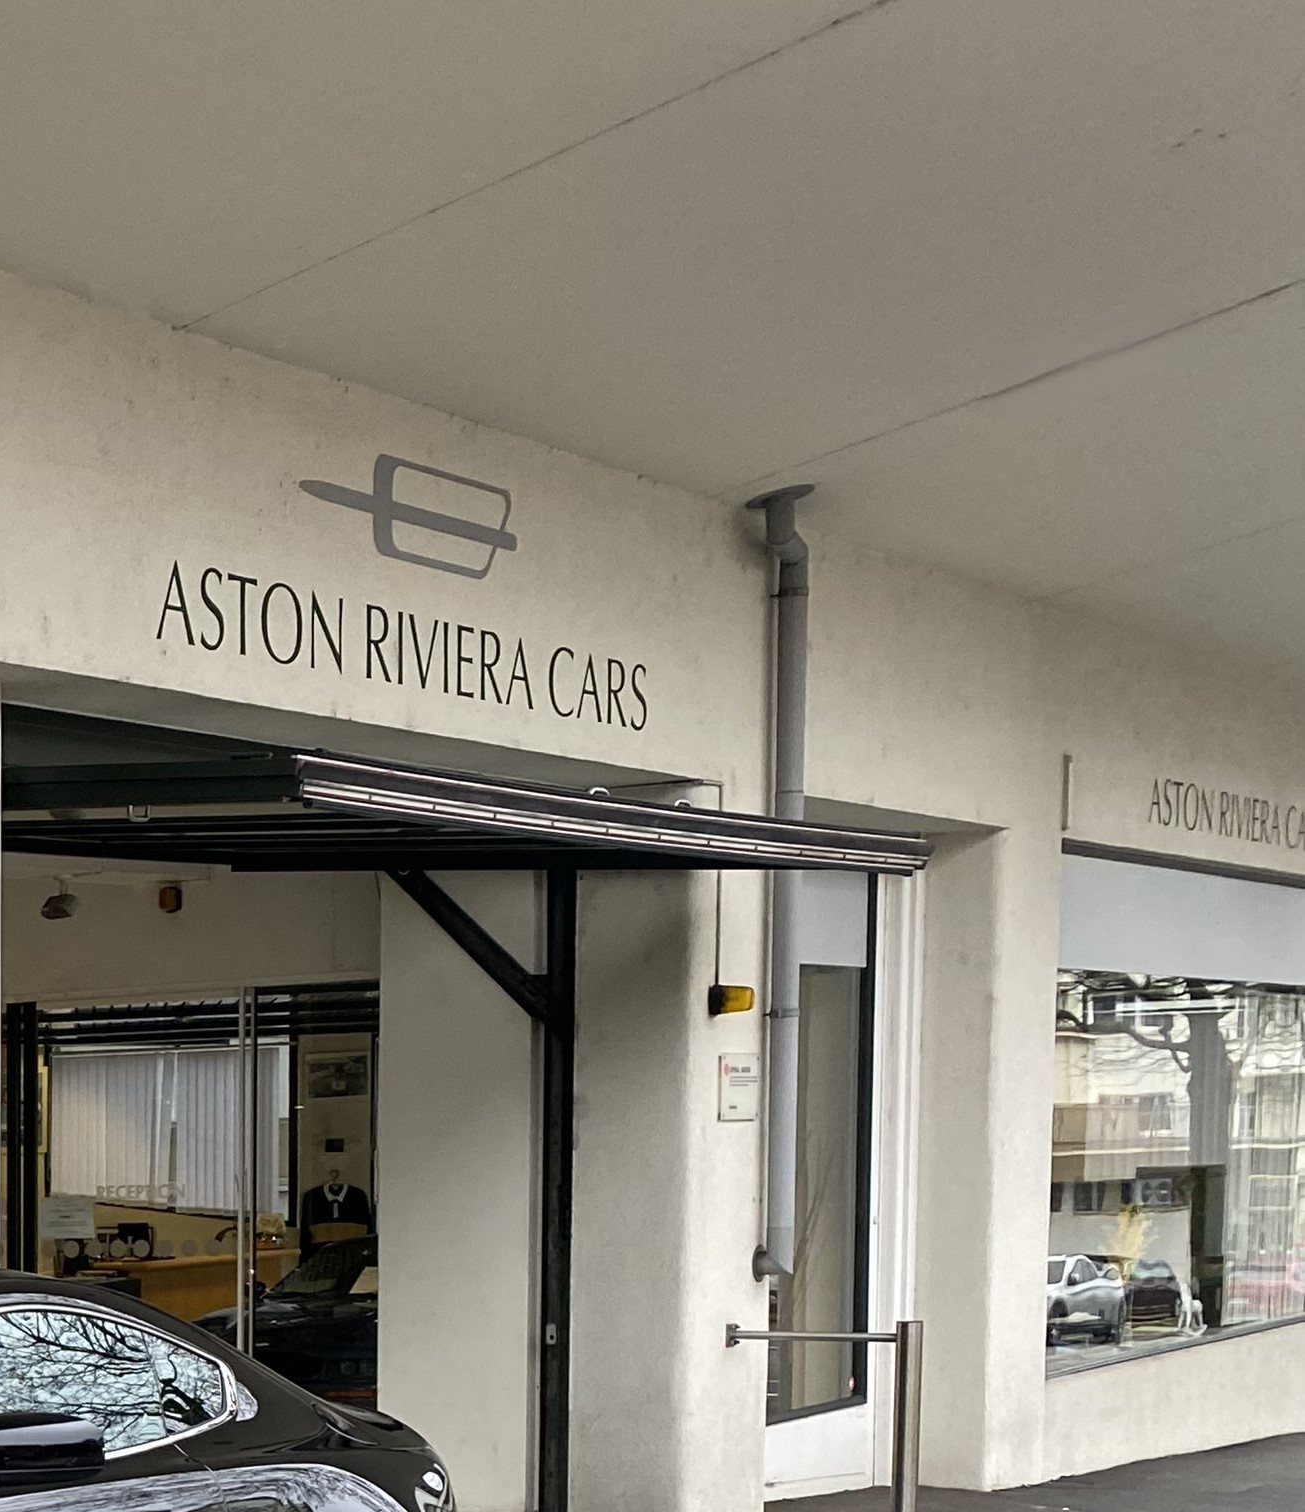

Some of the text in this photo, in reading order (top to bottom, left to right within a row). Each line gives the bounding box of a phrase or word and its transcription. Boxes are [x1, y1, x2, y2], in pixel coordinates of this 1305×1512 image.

[156, 559, 649, 732] ASTON RIVIERA CARS
[1148, 778, 1215, 831] ASTON
[1219, 791, 1281, 846] RIVIERA
[96, 1183, 186, 1199] RECEPTION
